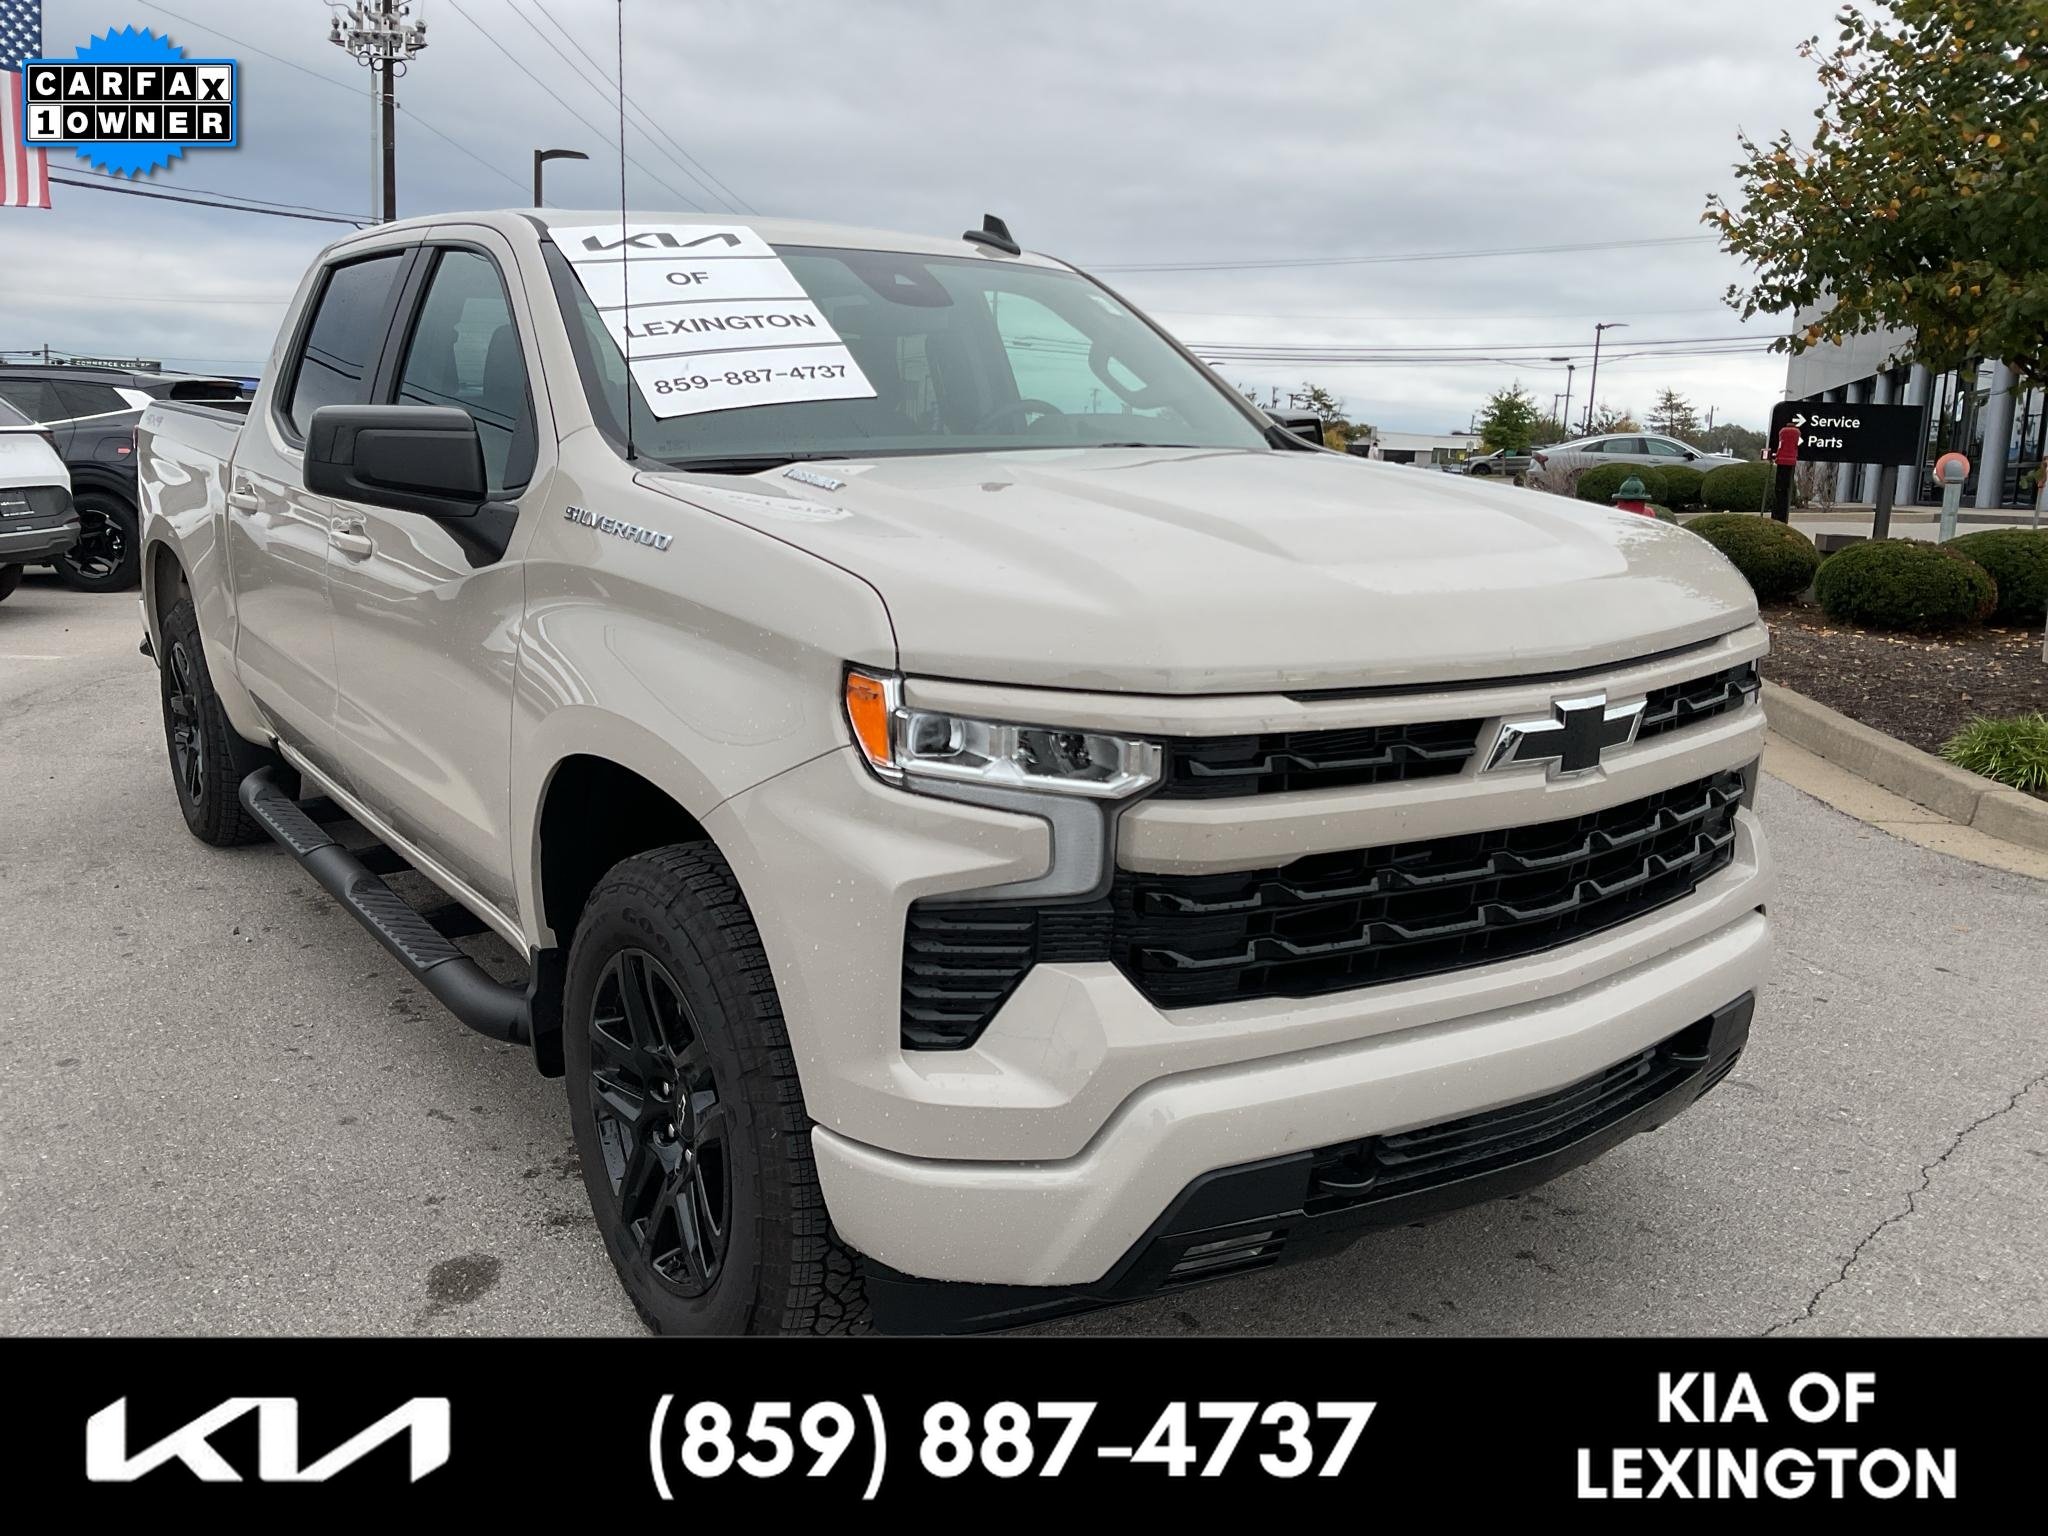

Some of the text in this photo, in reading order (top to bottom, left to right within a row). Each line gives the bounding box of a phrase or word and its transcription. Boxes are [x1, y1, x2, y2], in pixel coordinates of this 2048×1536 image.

[581, 232, 742, 252] KIA
[665, 271, 709, 286] OF
[624, 313, 817, 339] LEXINGTON
[653, 364, 846, 395] 859-887-4737
[1810, 415, 1861, 429] Service
[1807, 435, 1843, 449] Parts
[563, 505, 674, 551] SILVERADO
